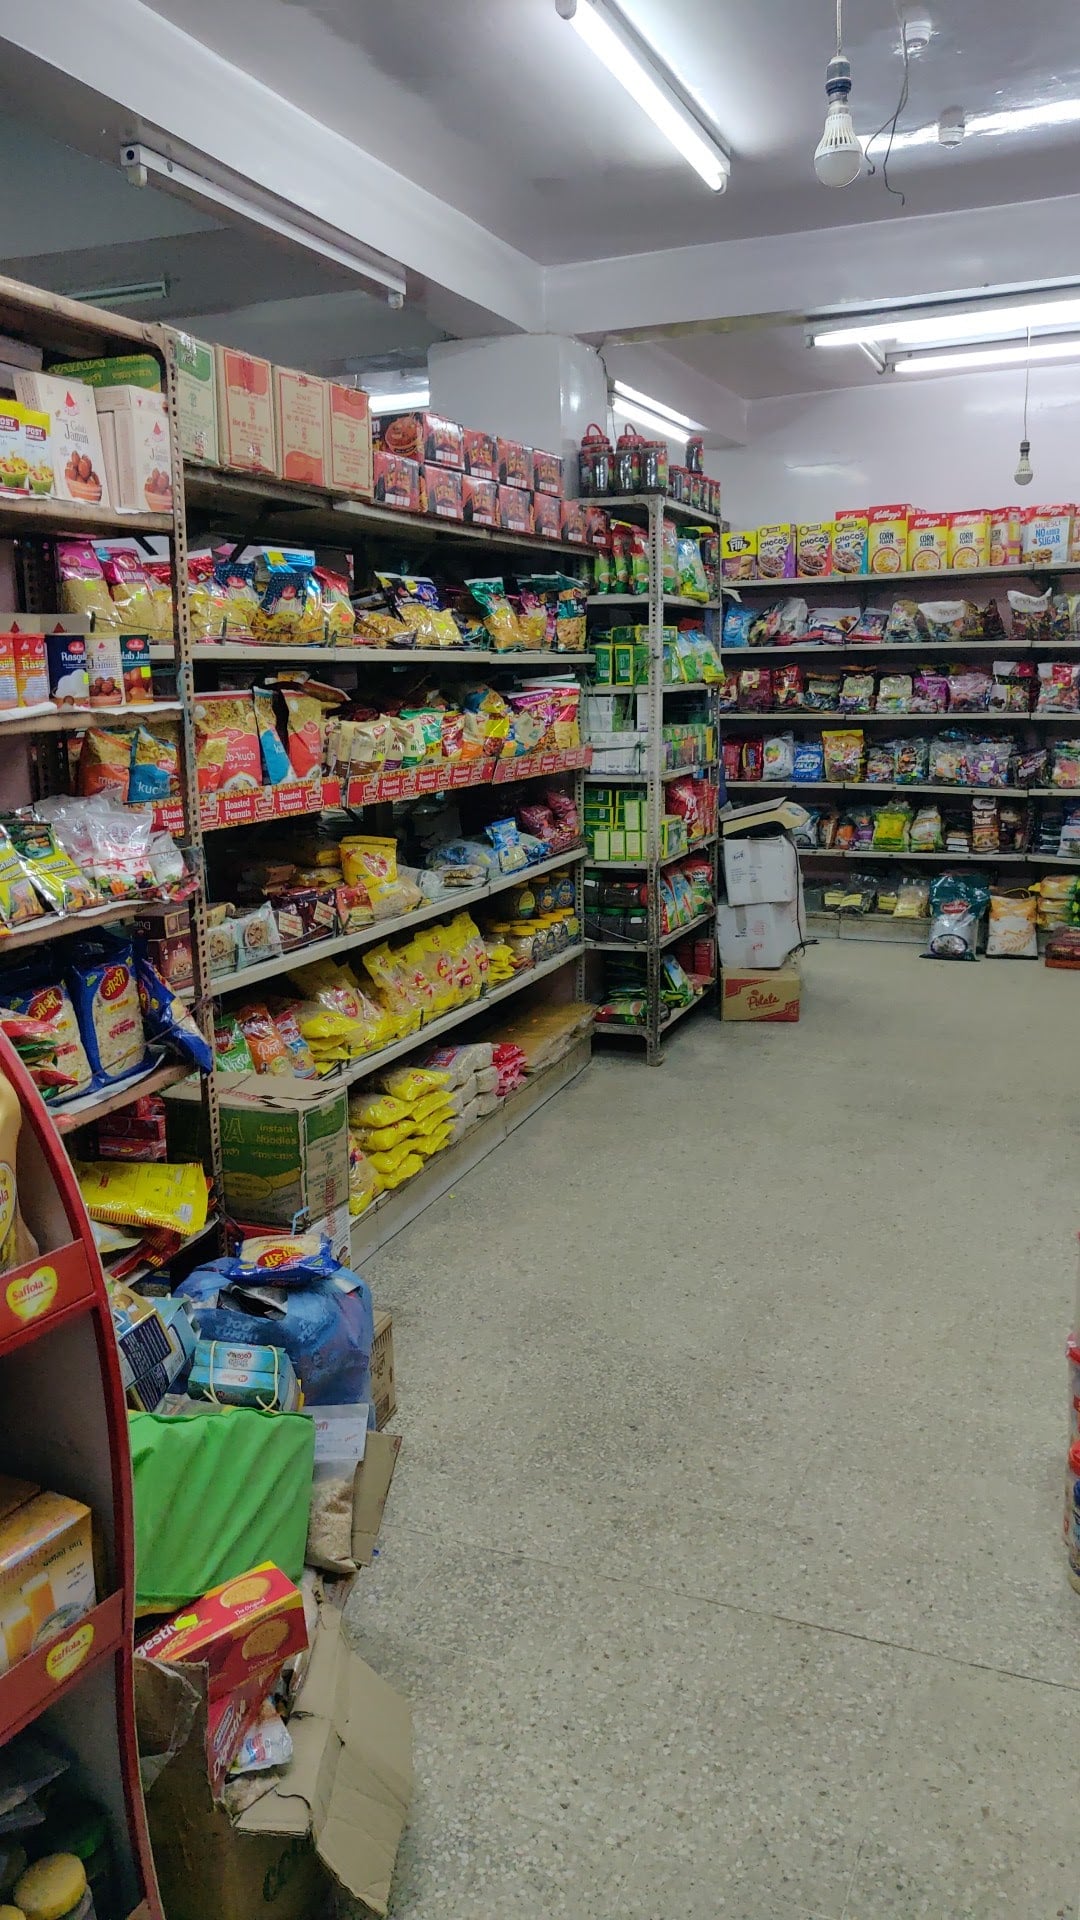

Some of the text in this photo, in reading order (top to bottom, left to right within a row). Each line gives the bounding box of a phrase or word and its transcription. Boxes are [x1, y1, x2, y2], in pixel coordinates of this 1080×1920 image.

[26, 427, 43, 436] POST
[835, 532, 865, 544] CHOCOS
[880, 532, 894, 540] CORN
[960, 532, 973, 540] CORN
[1036, 529, 1045, 537] NO
[760, 537, 787, 549] CHOCOS
[800, 536, 829, 547] CHOCOS
[1038, 535, 1061, 547] SUGAR
[279, 790, 302, 802] Roasted
[224, 798, 251, 810] Roasted
[280, 800, 303, 811] Peanuts
[225, 809, 252, 820] Peanuts
[104, 968, 126, 997] जोशी
[260, 1124, 293, 1133] Instant
[12, 1279, 44, 1299] Saffola
[51, 1640, 81, 1666] Saffola
